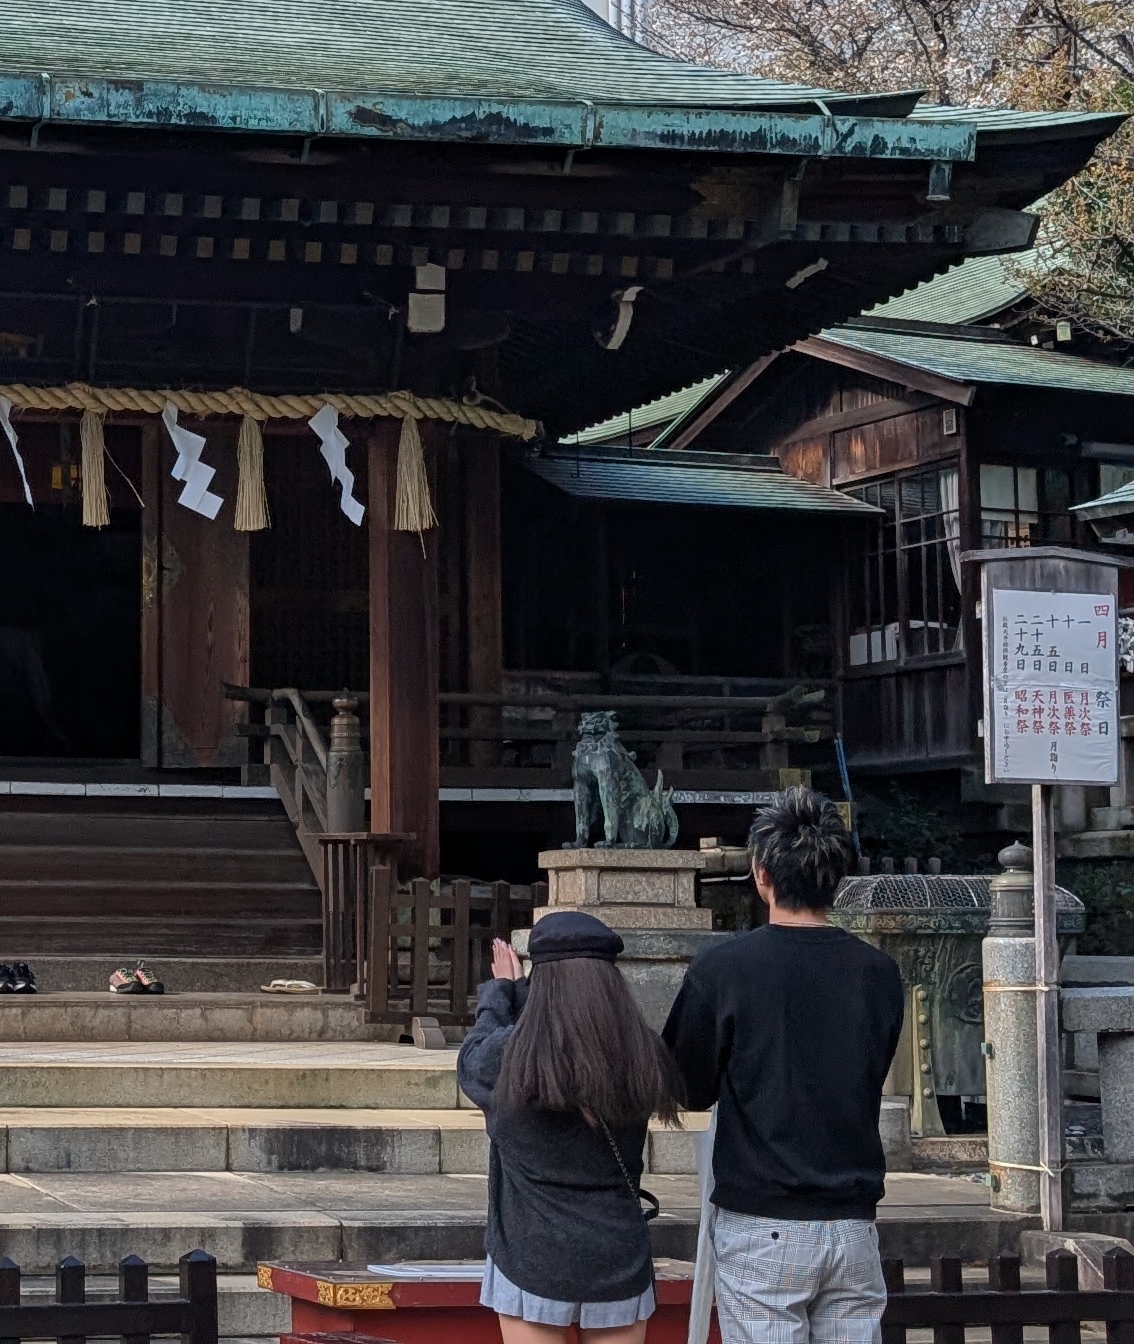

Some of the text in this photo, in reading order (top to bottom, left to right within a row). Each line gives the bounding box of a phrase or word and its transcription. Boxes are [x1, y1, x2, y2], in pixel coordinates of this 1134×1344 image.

[1014, 614, 1029, 734] 二十九日 昭和祭
[1031, 615, 1045, 735] 二十五日 天神祭
[1046, 614, 1061, 672] 十五日
[1062, 614, 1077, 736] 十日 医薬祭
[1078, 620, 1092, 736] 一日 月次祭
[1094, 605, 1112, 736] 四月 祭日
[1047, 690, 1061, 736] 月次祭
